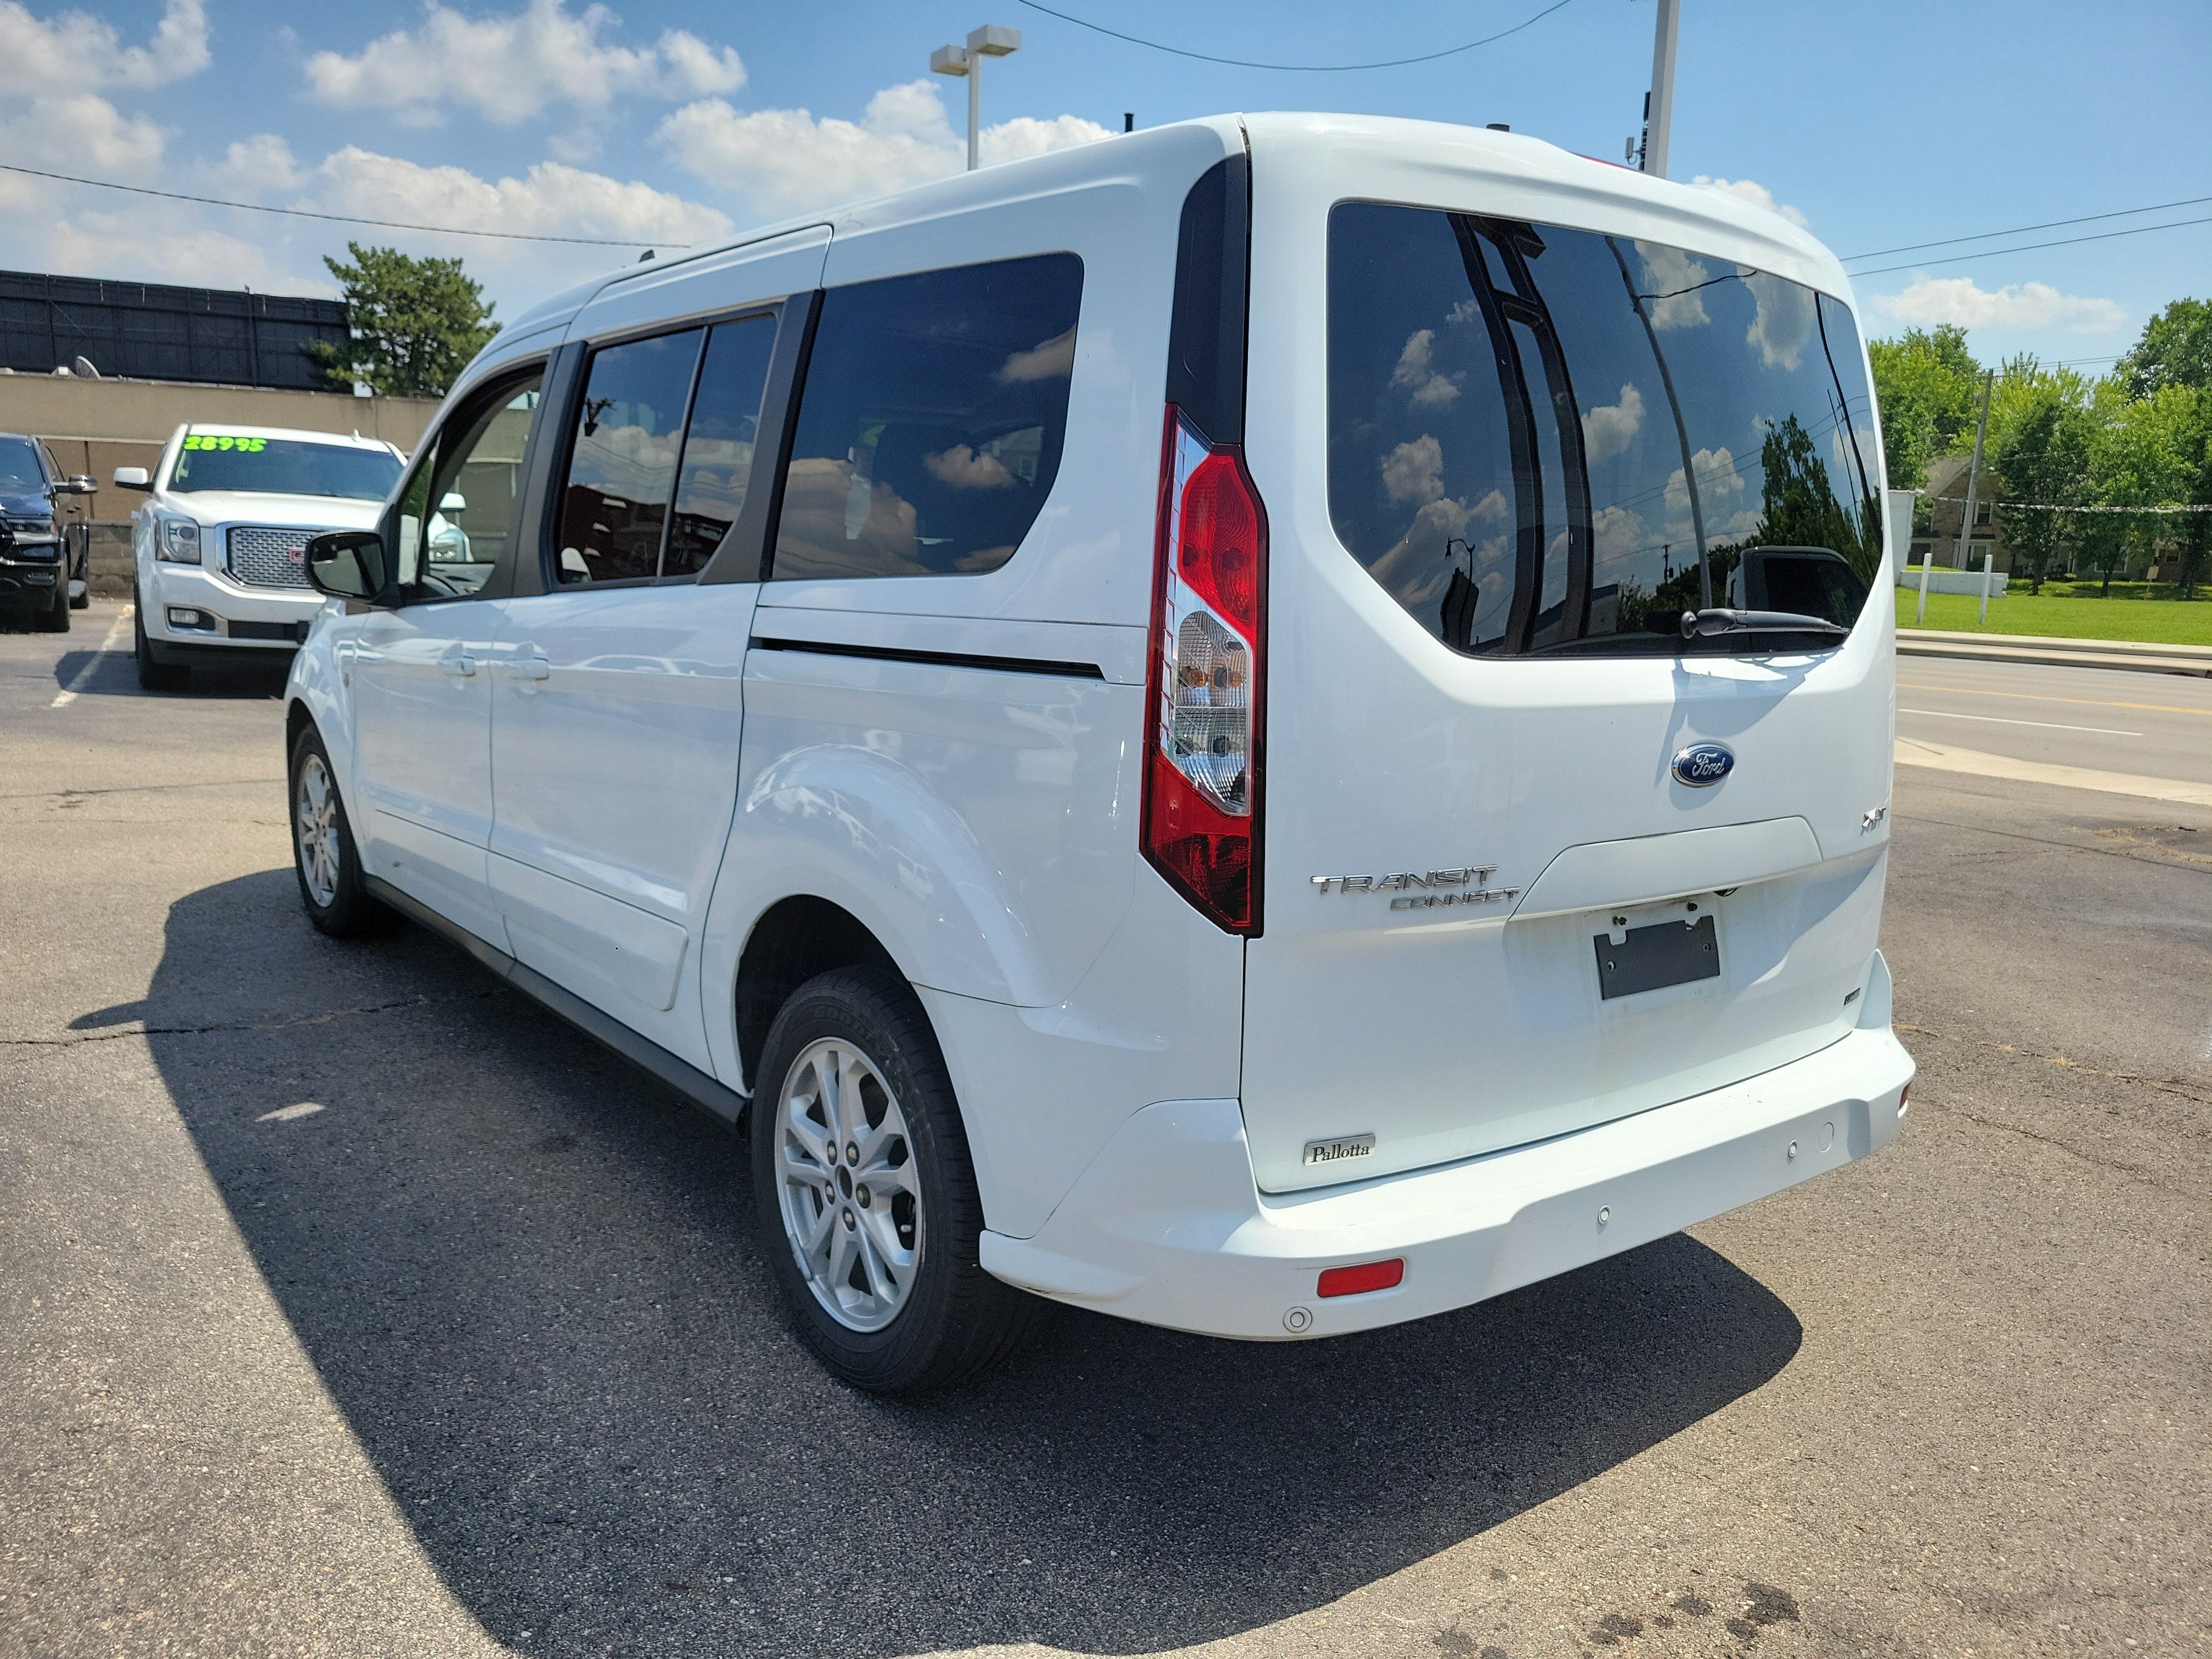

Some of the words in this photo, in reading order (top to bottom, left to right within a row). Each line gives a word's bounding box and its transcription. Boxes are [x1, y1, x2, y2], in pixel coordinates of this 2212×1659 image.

[183, 435, 268, 453] 28995
[1691, 752, 1726, 777] Ford
[1310, 864, 1499, 895] TRANSIT
[1390, 886, 1521, 911] CONNECT
[1310, 1143, 1370, 1163] Pallotta
